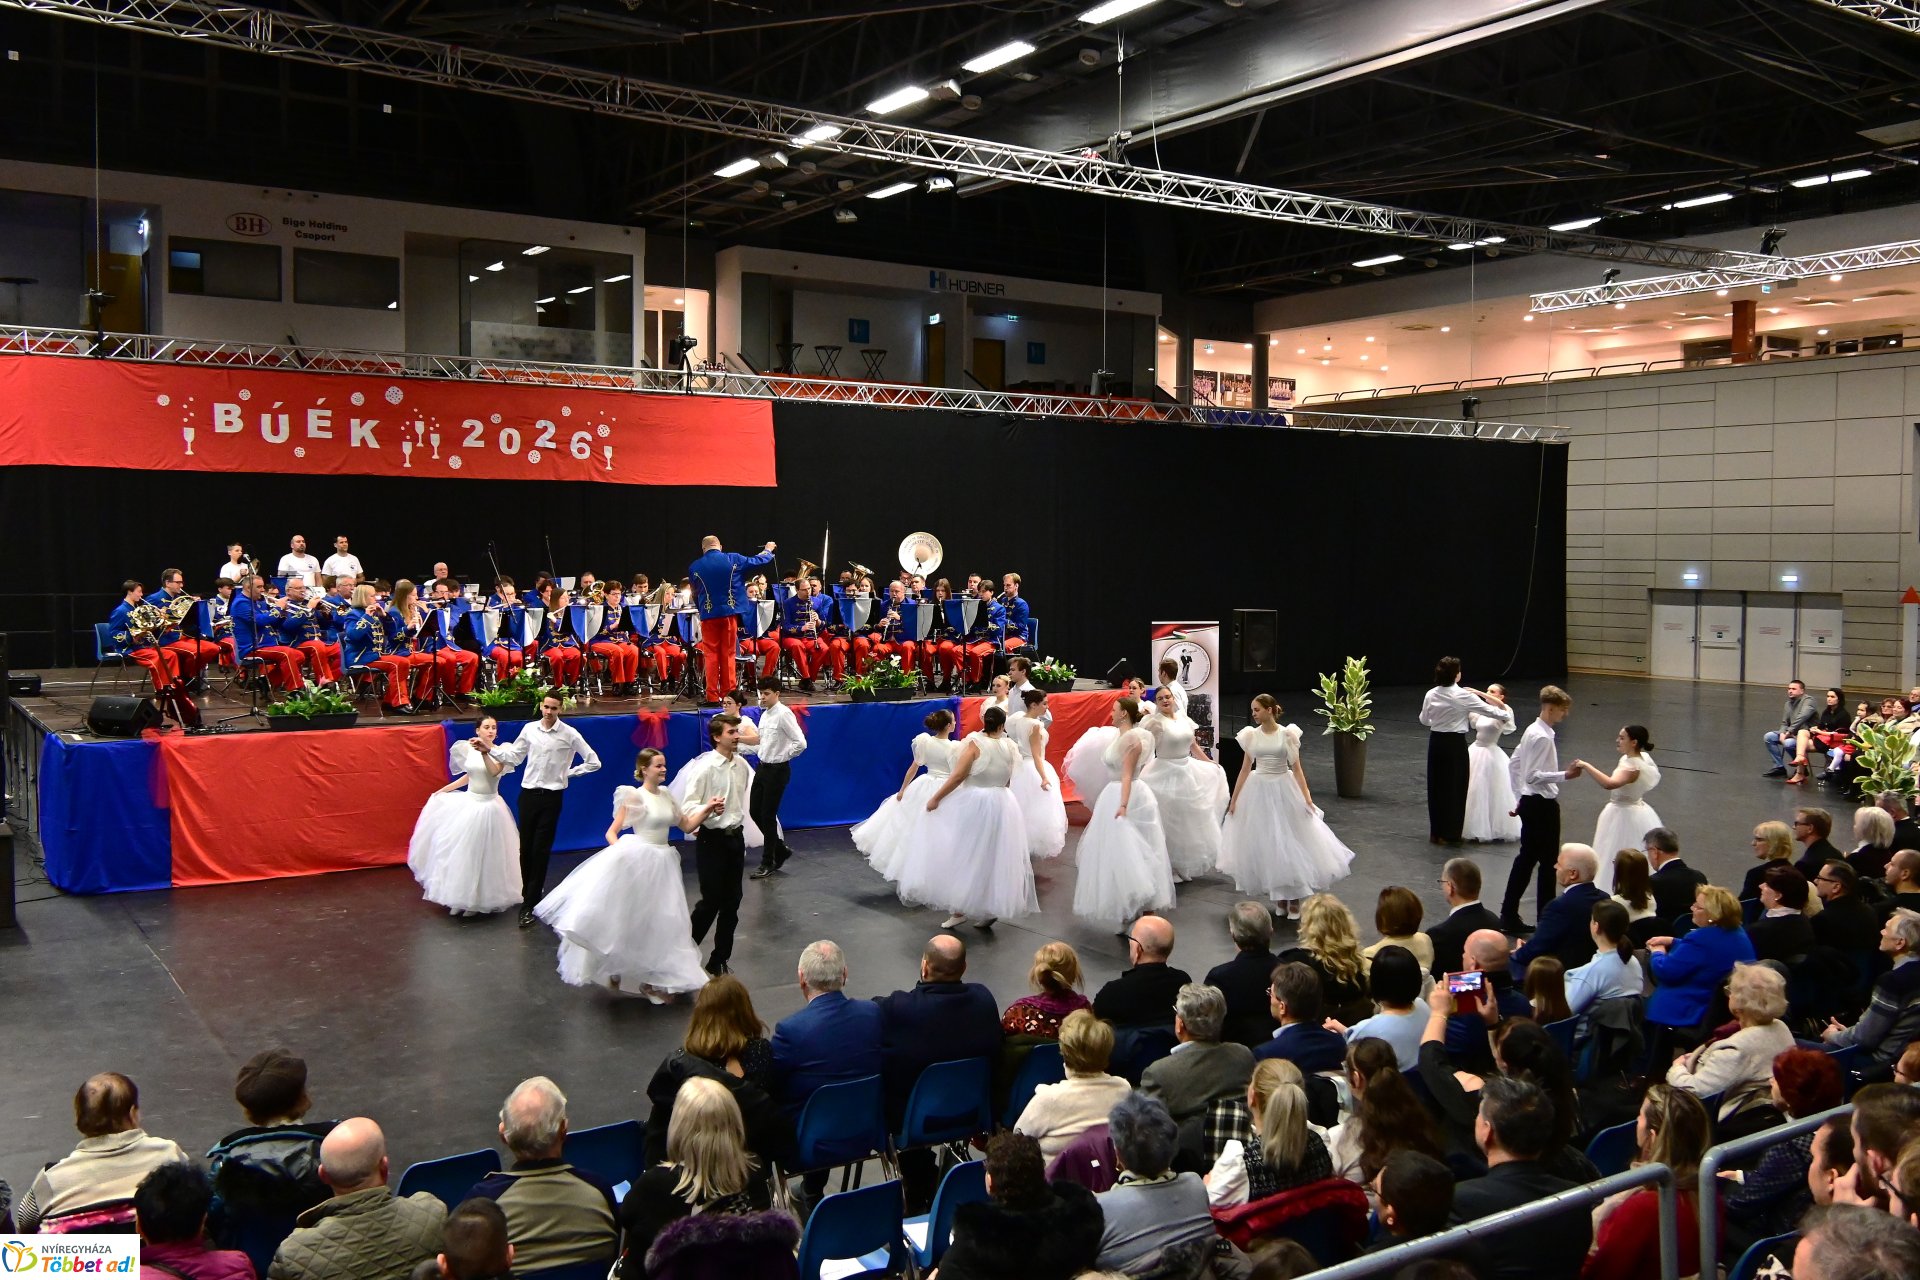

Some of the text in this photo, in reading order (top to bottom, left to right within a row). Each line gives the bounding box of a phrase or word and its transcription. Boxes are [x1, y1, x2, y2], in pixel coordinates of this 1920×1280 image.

[235, 216, 264, 232] BH
[282, 217, 349, 232] Bige Holding
[295, 230, 336, 241] Csoport
[948, 279, 1005, 296] HÜBNER
[213, 397, 593, 460] BÚÉK 2026
